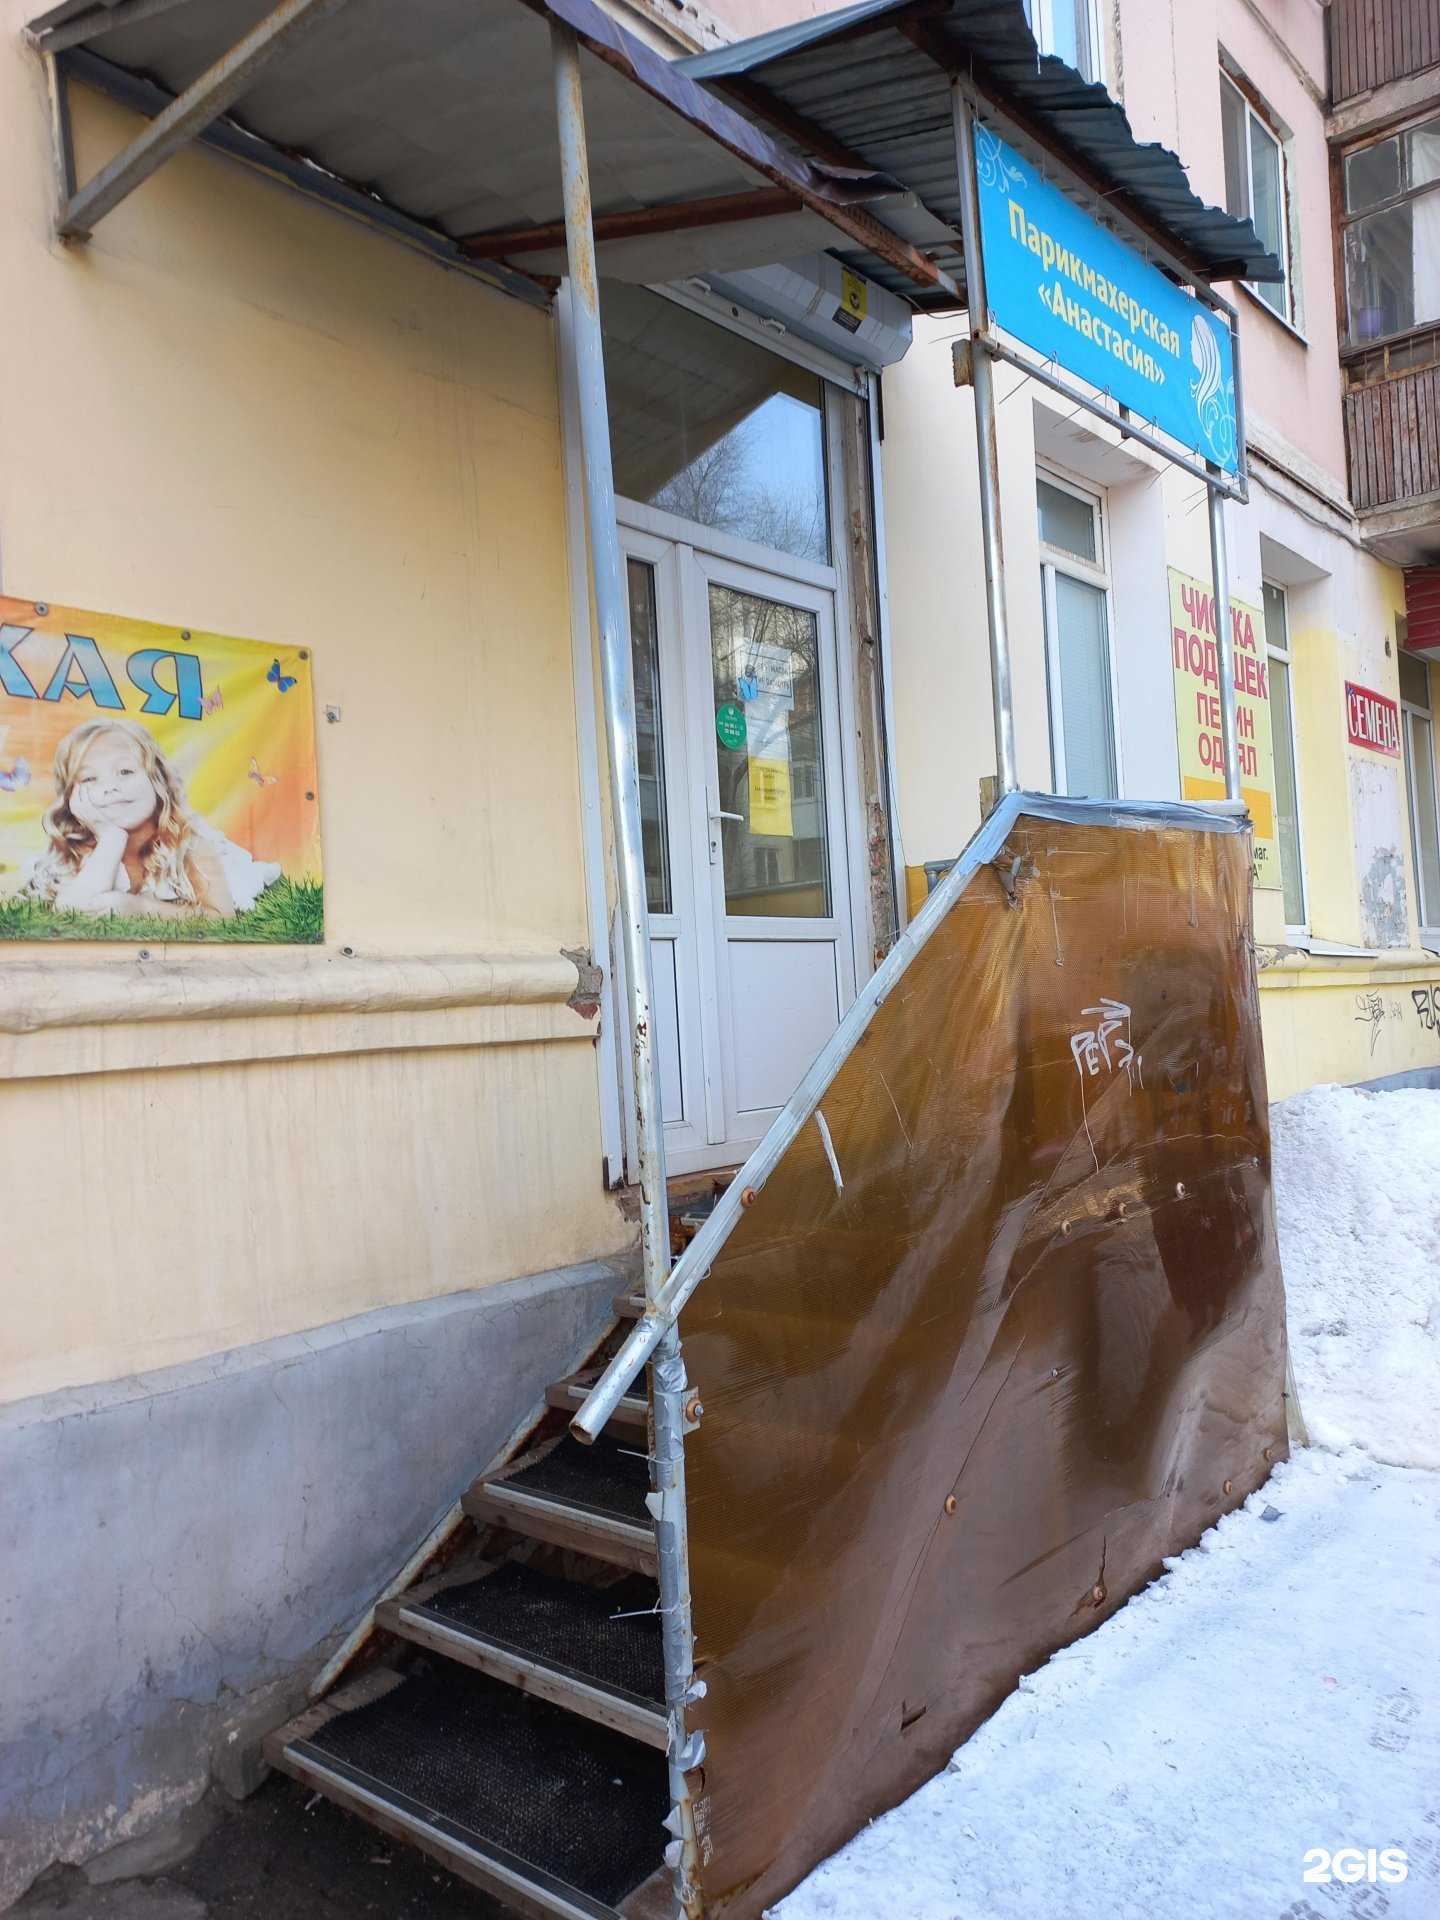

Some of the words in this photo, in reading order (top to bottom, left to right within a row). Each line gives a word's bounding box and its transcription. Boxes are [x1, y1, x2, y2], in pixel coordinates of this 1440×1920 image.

[1008, 199, 1180, 358] Парикмахерская
[1038, 281, 1165, 385] «Анастасия»
[1181, 584, 1257, 653] ЧИСКА
[1174, 627, 1268, 700] ПОДШЕК
[1196, 691, 1254, 740] ПЕИН
[1347, 693, 1400, 751] СЕМЕНА
[1198, 732, 1258, 776] ОДЯЛ
